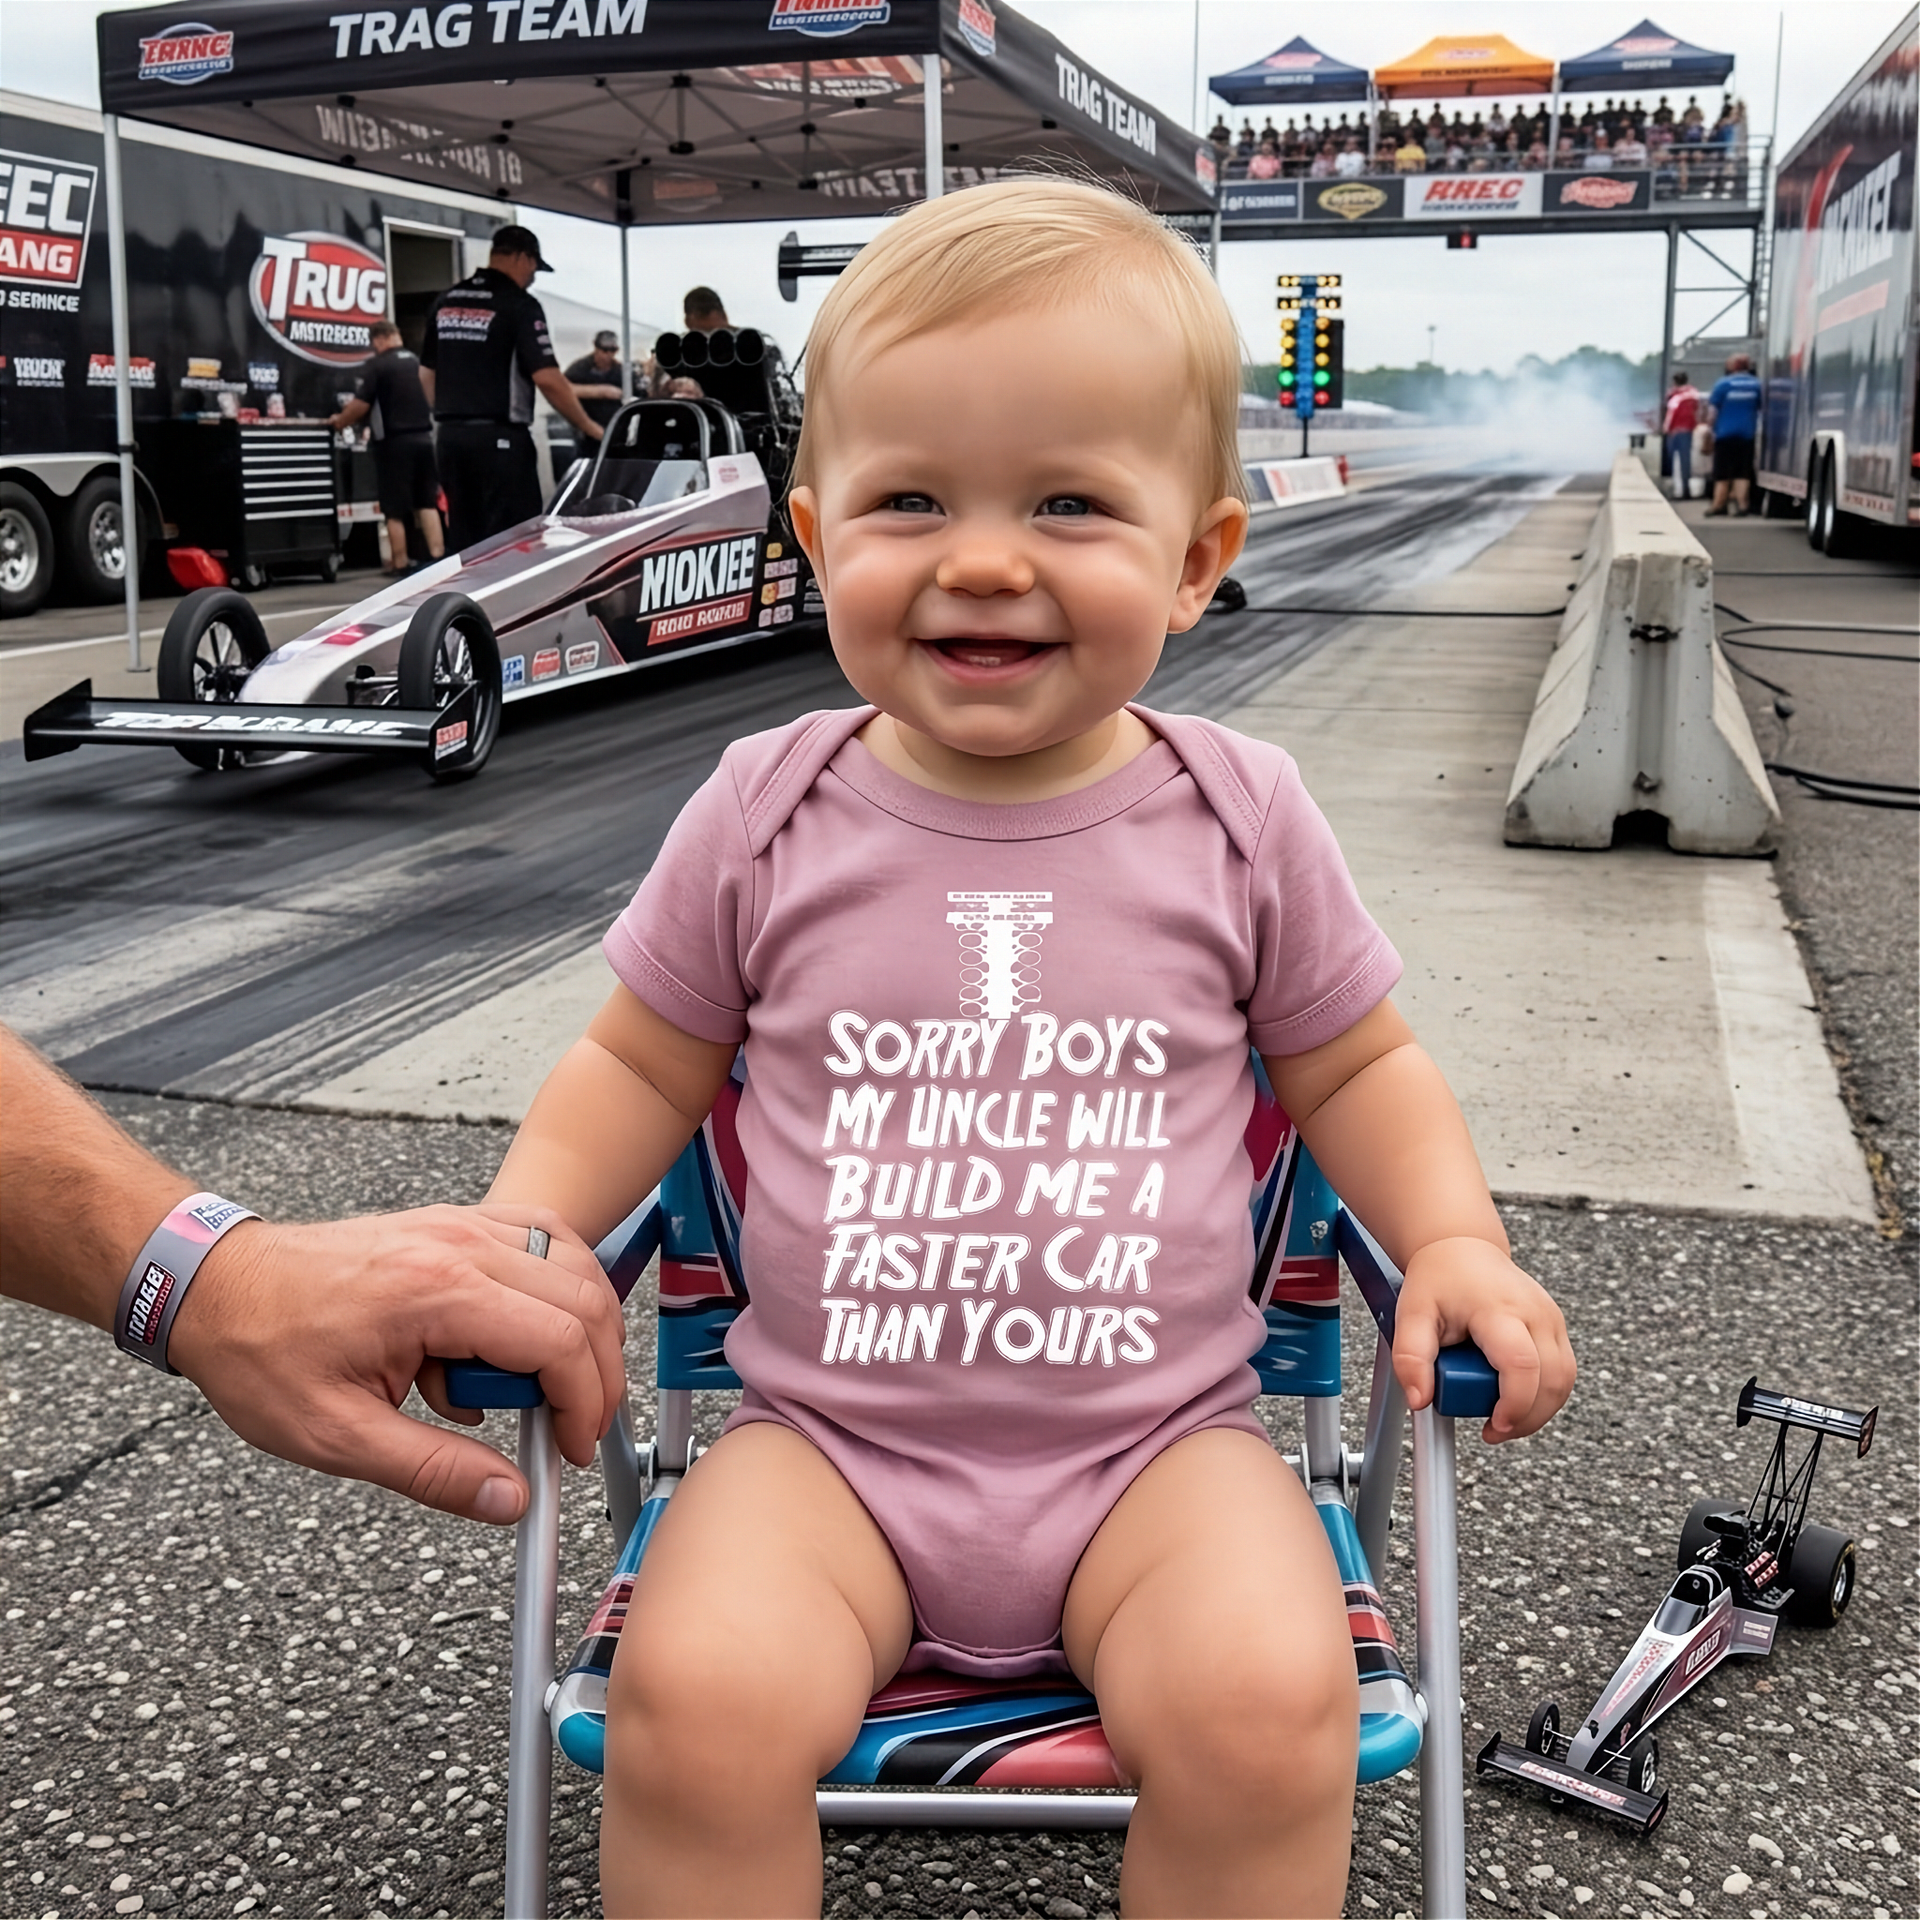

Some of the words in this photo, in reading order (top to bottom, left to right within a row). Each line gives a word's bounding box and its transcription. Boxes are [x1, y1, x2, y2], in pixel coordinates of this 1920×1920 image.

[329, 3, 473, 58] TRAG
[487, 0, 648, 43] TEAM
[1055, 52, 1102, 125] TRAG
[1104, 86, 1156, 156] TEAM
[0, 162, 91, 235] EC
[263, 236, 386, 320] TRUG
[823, 1010, 1009, 1078] SORRY
[1019, 1010, 1170, 1080] BOYS
[822, 1081, 897, 1149] MY
[907, 1083, 1058, 1149] UNCLE
[1066, 1086, 1171, 1152] WILL
[823, 1154, 1005, 1224] BUILD
[1015, 1157, 1119, 1218] ME
[1130, 1159, 1165, 1220] A
[820, 1222, 1031, 1294] FASTER
[1042, 1224, 1161, 1294] CAR
[820, 1297, 948, 1365] THAN
[960, 1297, 1161, 1367] YOURS
